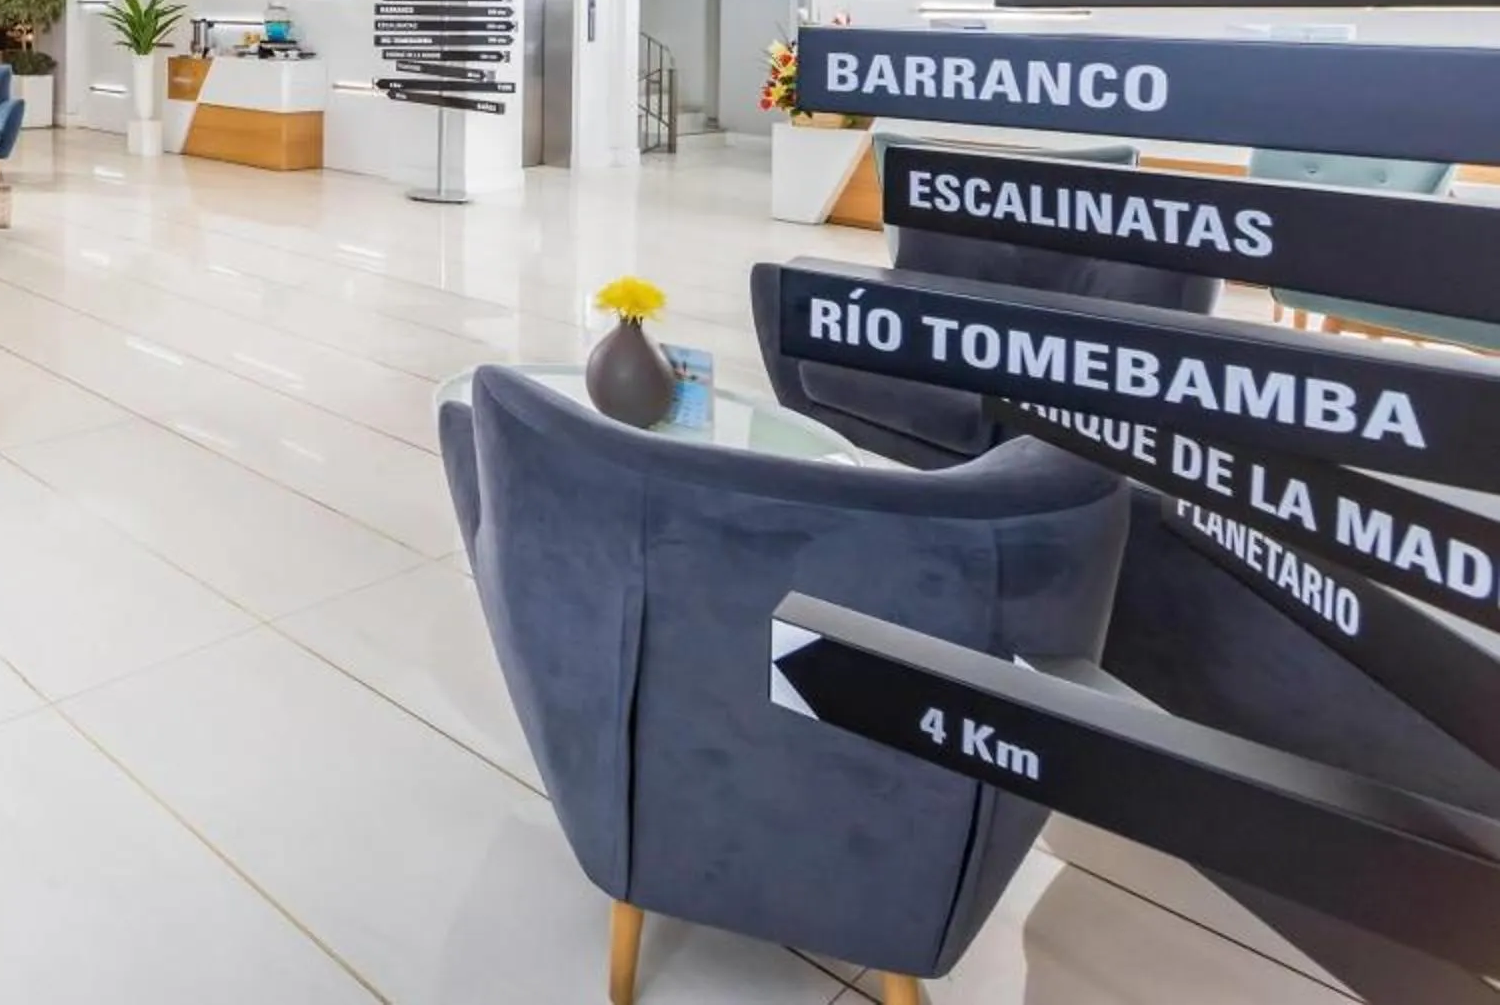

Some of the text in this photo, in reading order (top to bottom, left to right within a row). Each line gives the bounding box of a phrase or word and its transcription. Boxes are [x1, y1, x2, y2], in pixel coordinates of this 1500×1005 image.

[827, 52, 1169, 113] BARRANCO
[907, 171, 1274, 258] ESCALINATAS
[809, 287, 1427, 449] RÍO TOMEBAMBA
[1000, 397, 1500, 609] RQUE DE LA MAD
[920, 707, 1040, 781] 4 Km
